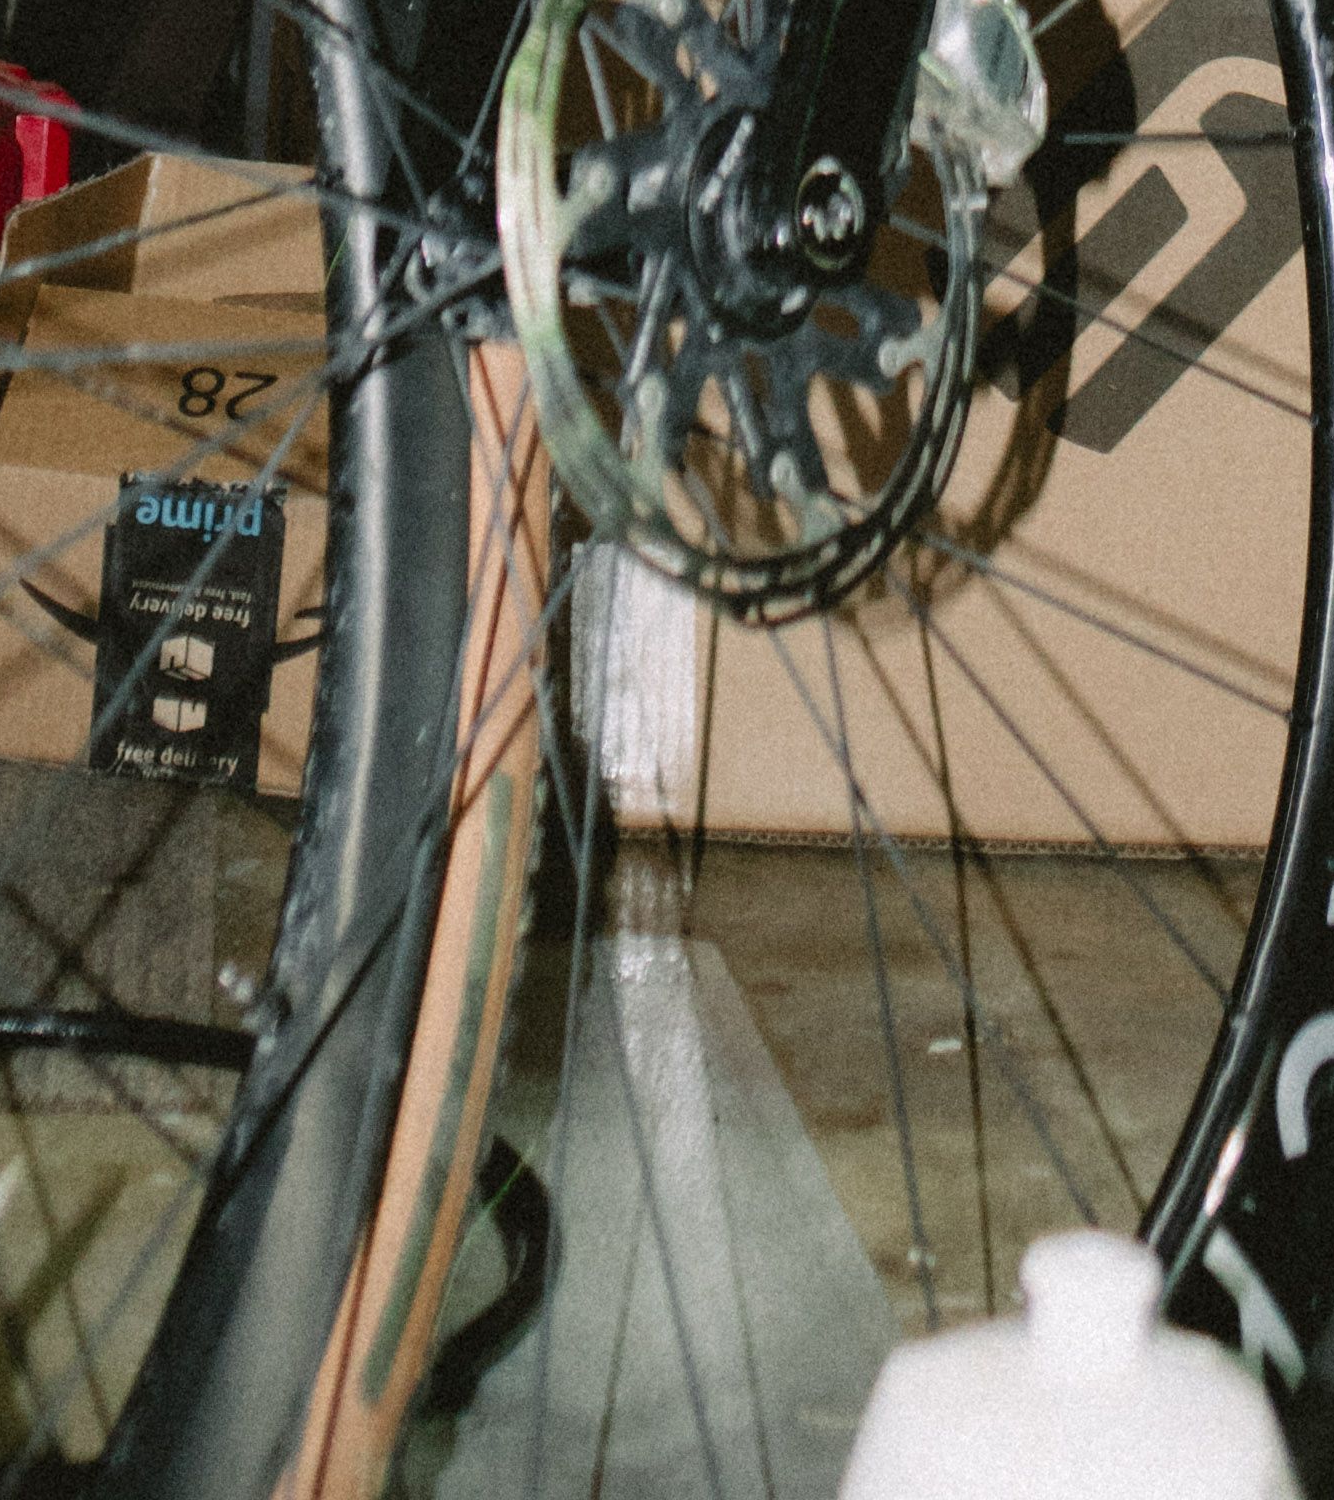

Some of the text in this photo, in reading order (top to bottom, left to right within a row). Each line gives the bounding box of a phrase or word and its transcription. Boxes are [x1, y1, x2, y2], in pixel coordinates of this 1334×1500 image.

[178, 367, 277, 420] 28
[136, 495, 264, 543] prime
[212, 605, 251, 629] free
[116, 740, 156, 766] free
